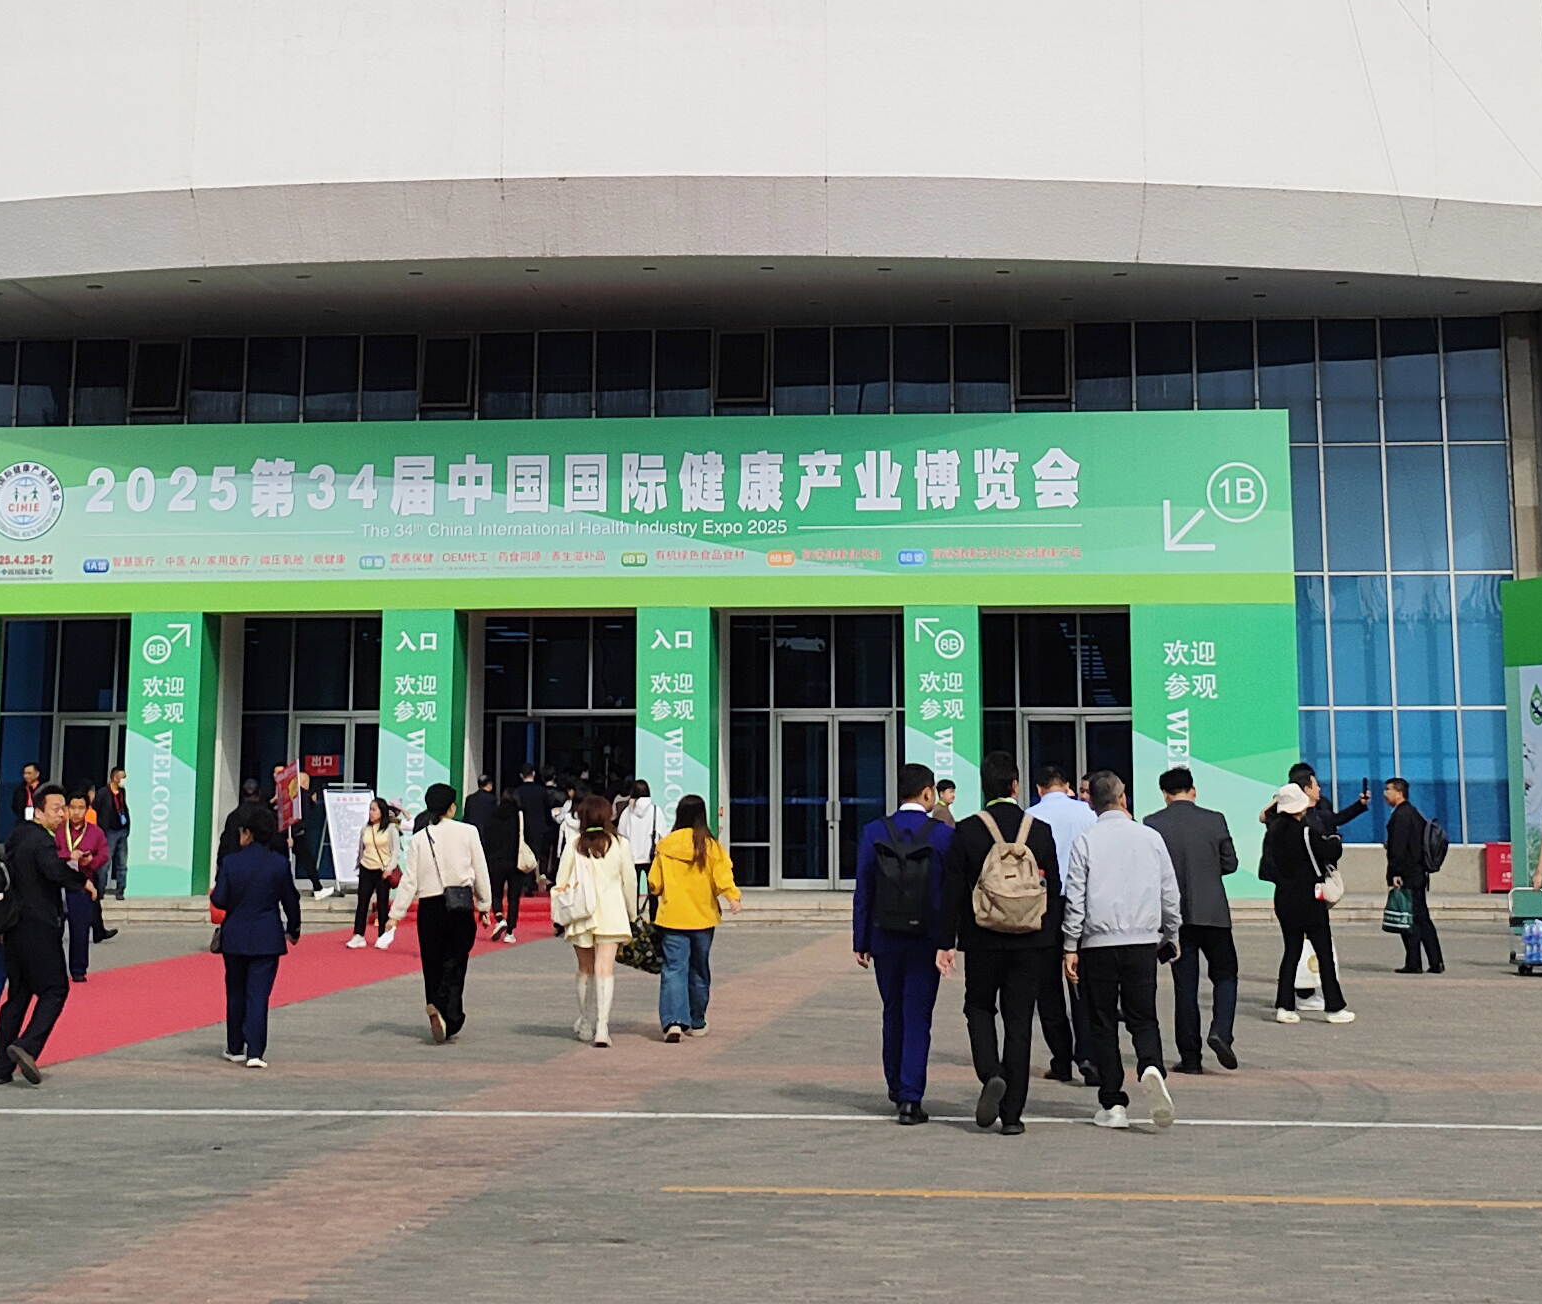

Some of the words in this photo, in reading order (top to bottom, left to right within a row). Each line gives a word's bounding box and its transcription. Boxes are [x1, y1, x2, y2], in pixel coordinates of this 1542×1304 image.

[85, 447, 1081, 520] 2025第34届中国国际健康产业博览会
[1219, 477, 1256, 504] 1B
[8, 503, 40, 513] CIHIE
[361, 524, 390, 538] The
[394, 523, 423, 538] 34th
[428, 523, 473, 537] China
[478, 521, 574, 537] International
[579, 520, 630, 535] Health
[635, 519, 697, 538] Industry
[702, 519, 743, 538] Expo
[747, 519, 788, 535] 2025
[148, 644, 167, 657] 8B
[396, 631, 437, 651] 入口
[651, 629, 693, 650] 入口
[940, 638, 959, 651] 8B
[1163, 640, 1217, 667] 欢迎
[142, 676, 185, 697] 欢迎
[394, 674, 437, 695] 欢迎
[650, 672, 694, 694] 欢迎
[919, 671, 964, 693] 欢迎
[1164, 672, 1219, 700] 参观
[142, 702, 185, 724] 参观
[394, 700, 437, 722] 参观
[650, 699, 695, 722] 参观
[919, 697, 965, 721] 参观
[311, 755, 332, 766] 出口
[149, 729, 173, 861] WELCOME
